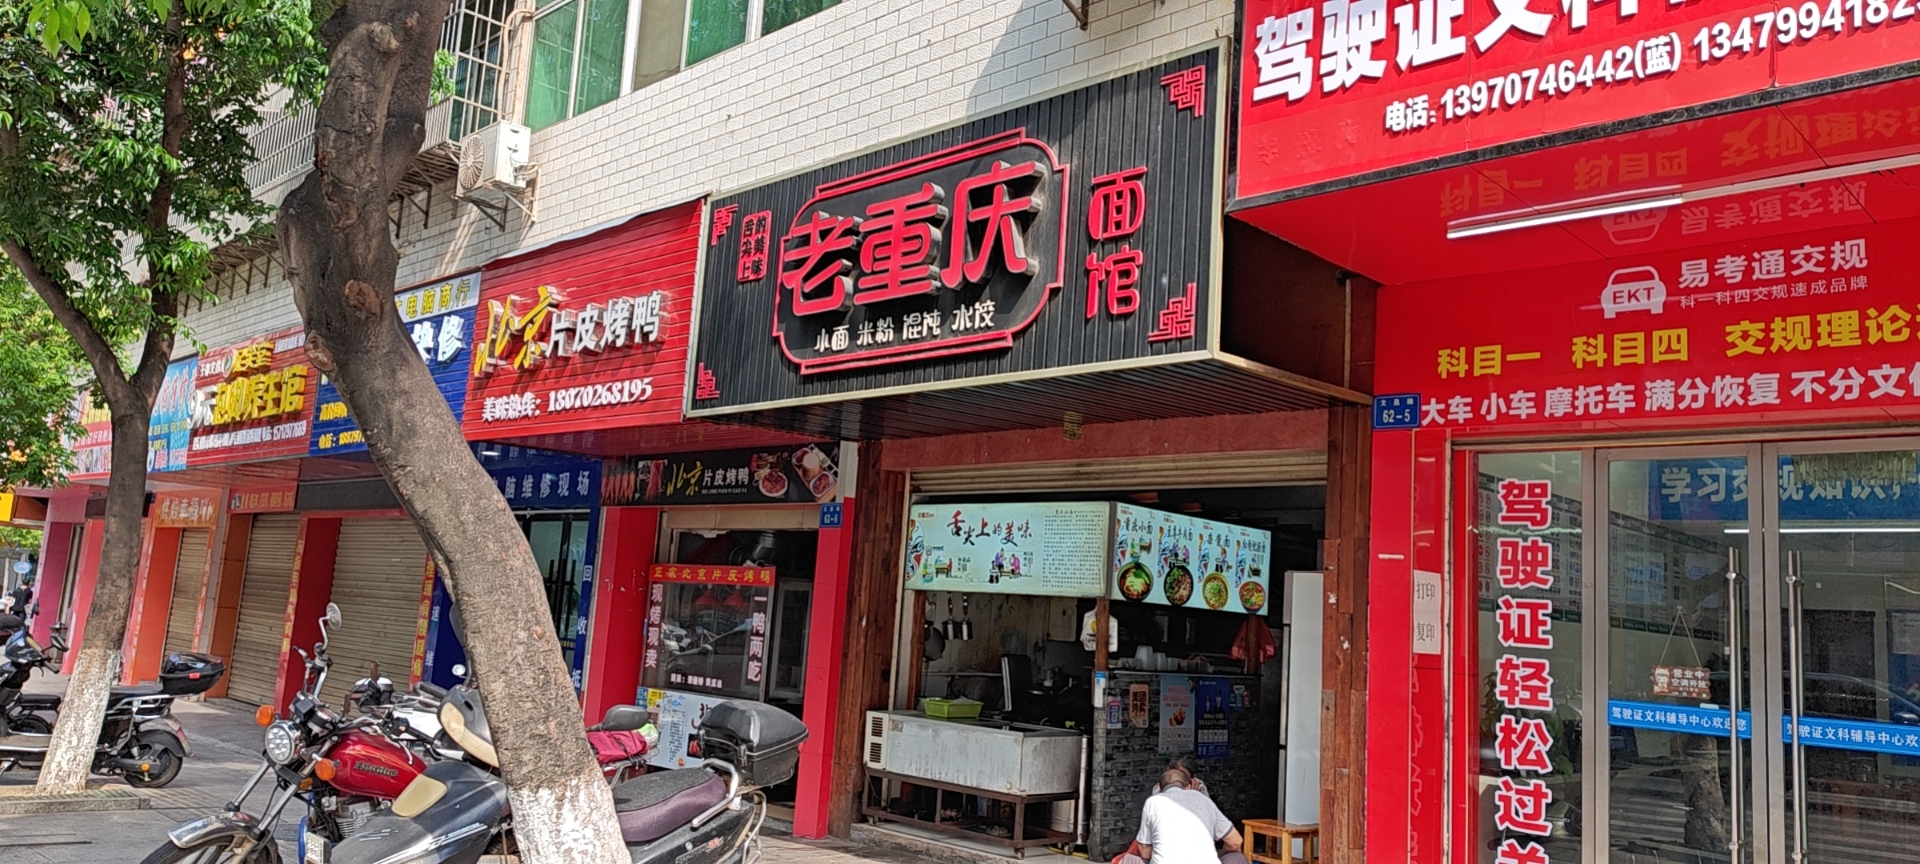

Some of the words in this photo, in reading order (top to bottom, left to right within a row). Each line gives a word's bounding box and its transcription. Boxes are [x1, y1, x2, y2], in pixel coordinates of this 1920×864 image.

[782, 160, 1041, 316] 老重庆
[1086, 166, 1148, 319] 面馆
[1678, 238, 1868, 289] 易考通交规
[1612, 286, 1656, 305] EKT
[1680, 275, 1868, 309] 科一科四交规速成品牌
[814, 324, 849, 353] 小面
[856, 318, 895, 347] 米粉
[950, 300, 996, 331] 水饺
[1725, 304, 1920, 358] 交规理论
[1437, 344, 1541, 379] 科目一
[1571, 328, 1689, 369] 科目四
[1382, 409, 1411, 423] 62-5
[1421, 395, 1474, 427] 大车
[1480, 389, 1537, 421] 小车
[1544, 382, 1637, 418] 摩托车
[1644, 373, 1781, 413] 满分恢复
[947, 510, 1032, 547] 舌尖上的美味
[654, 566, 771, 584] 正宗北京片皮烤鸭
[1416, 580, 1436, 601] 打印
[747, 595, 767, 682] 一鸭两吃
[1416, 621, 1435, 643] 复印
[1671, 678, 1708, 688] 空调开放
[1672, 668, 1705, 679] 营业中
